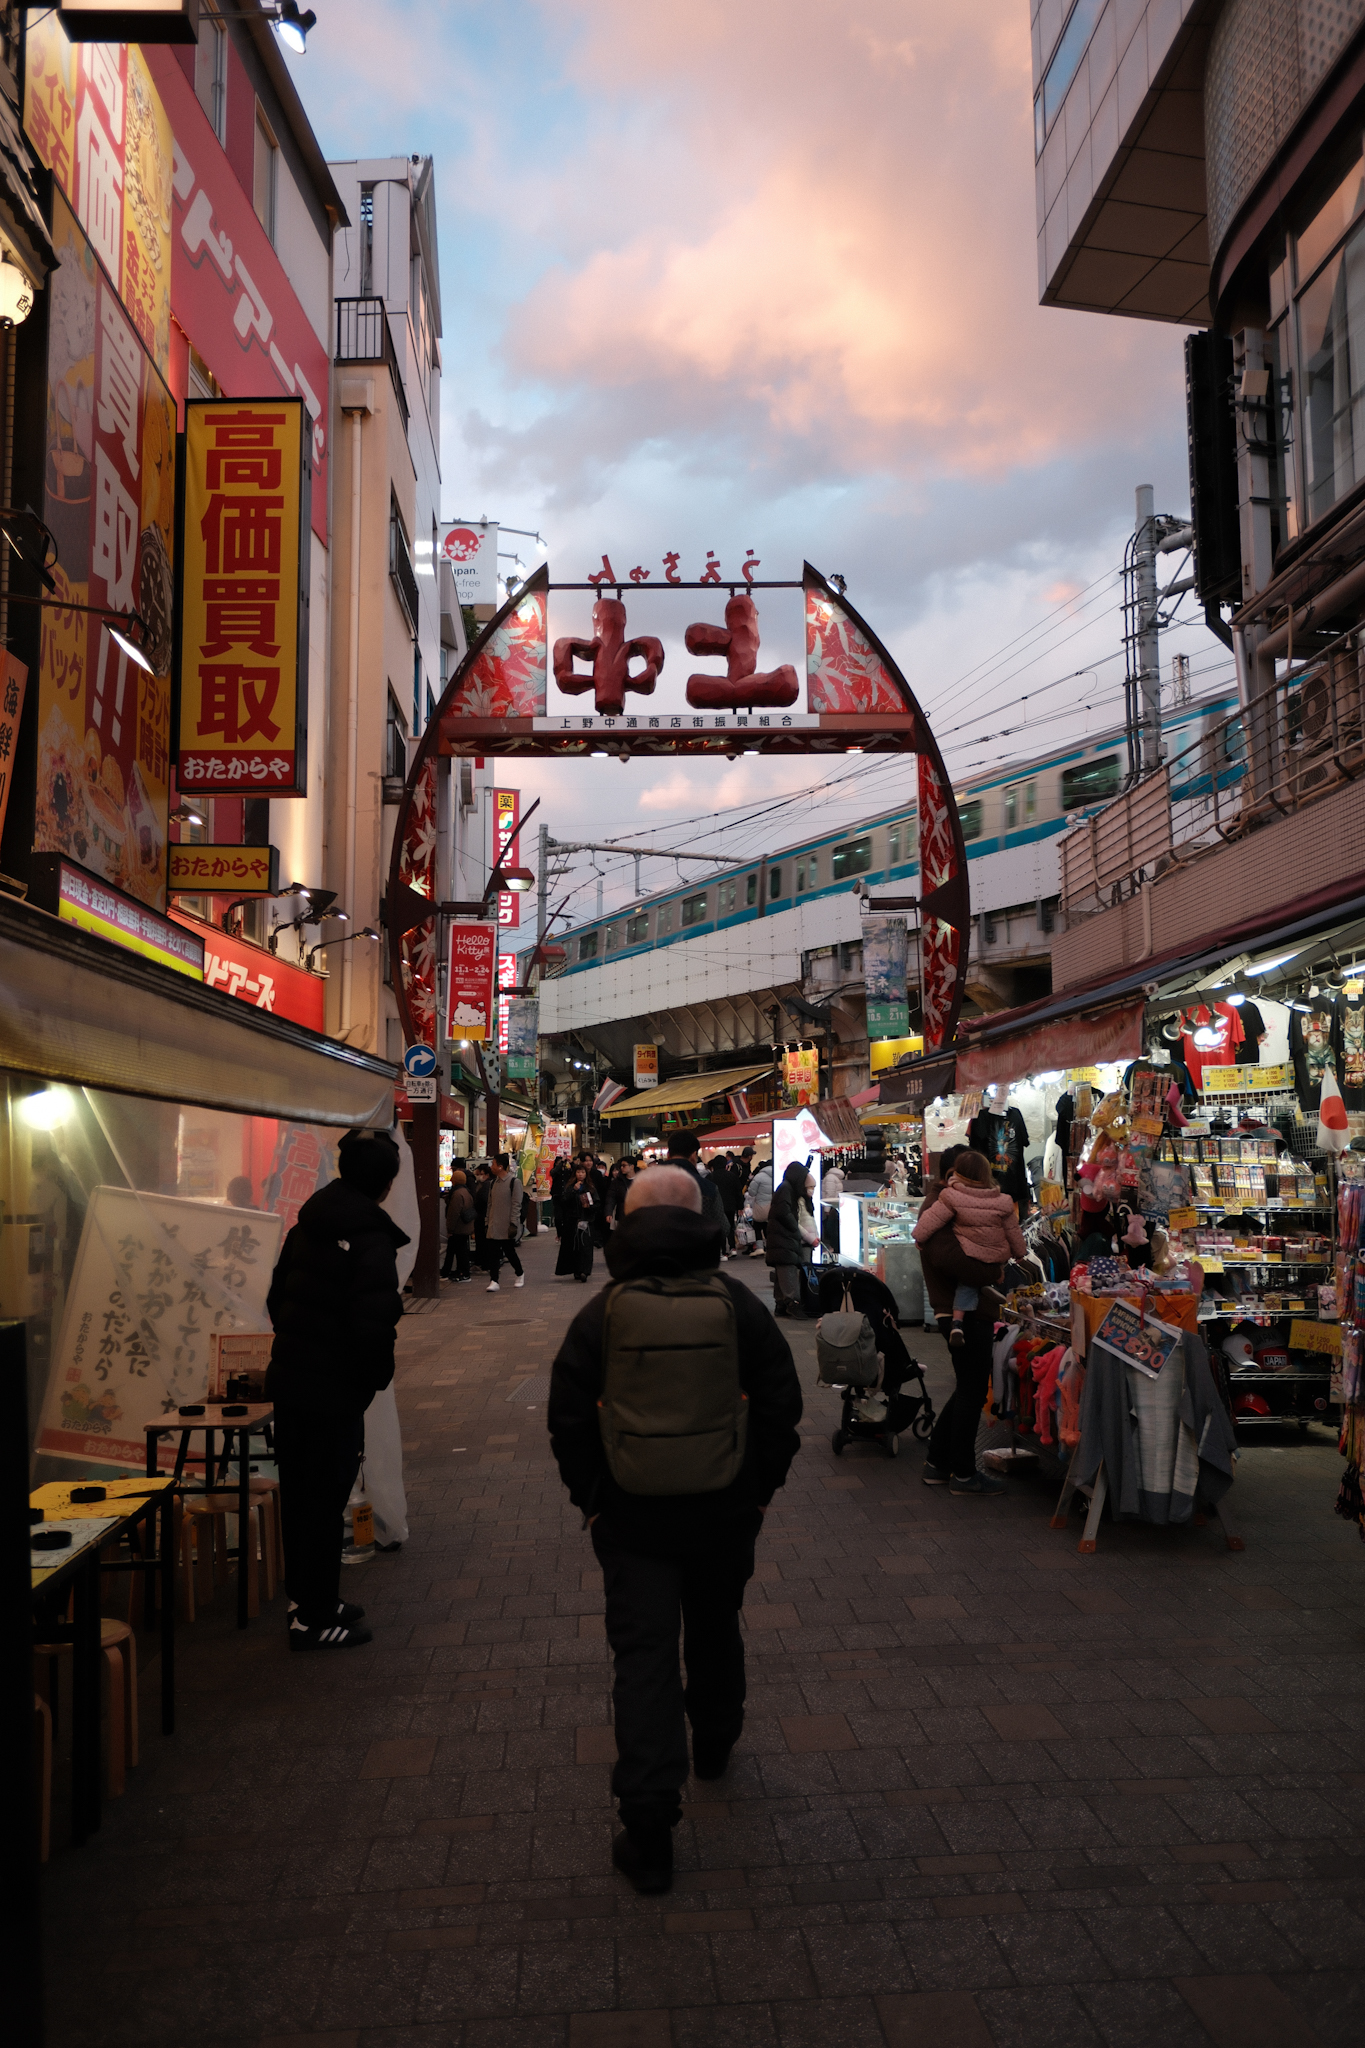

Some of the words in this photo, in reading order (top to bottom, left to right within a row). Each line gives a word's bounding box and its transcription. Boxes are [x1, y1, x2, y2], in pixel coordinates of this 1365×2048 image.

[197, 410, 286, 744] 高価買取
[39, 621, 84, 701] バッグ
[560, 715, 793, 729] 上野中通商店街振興組合
[139, 715, 168, 786] 時計
[183, 757, 290, 781] おたからや
[500, 794, 512, 809] 薬
[171, 855, 270, 879] おたからや
[456, 934, 490, 946] Hello
[457, 945, 485, 961] Kitty
[865, 975, 889, 989] モネ
[1112, 1307, 1141, 1328] JAPANES
[73, 1311, 93, 1365] おたからや
[1264, 1356, 1288, 1366] JAPAN
[60, 1419, 112, 1435] おたからや
[83, 1440, 146, 1461] おたからや
